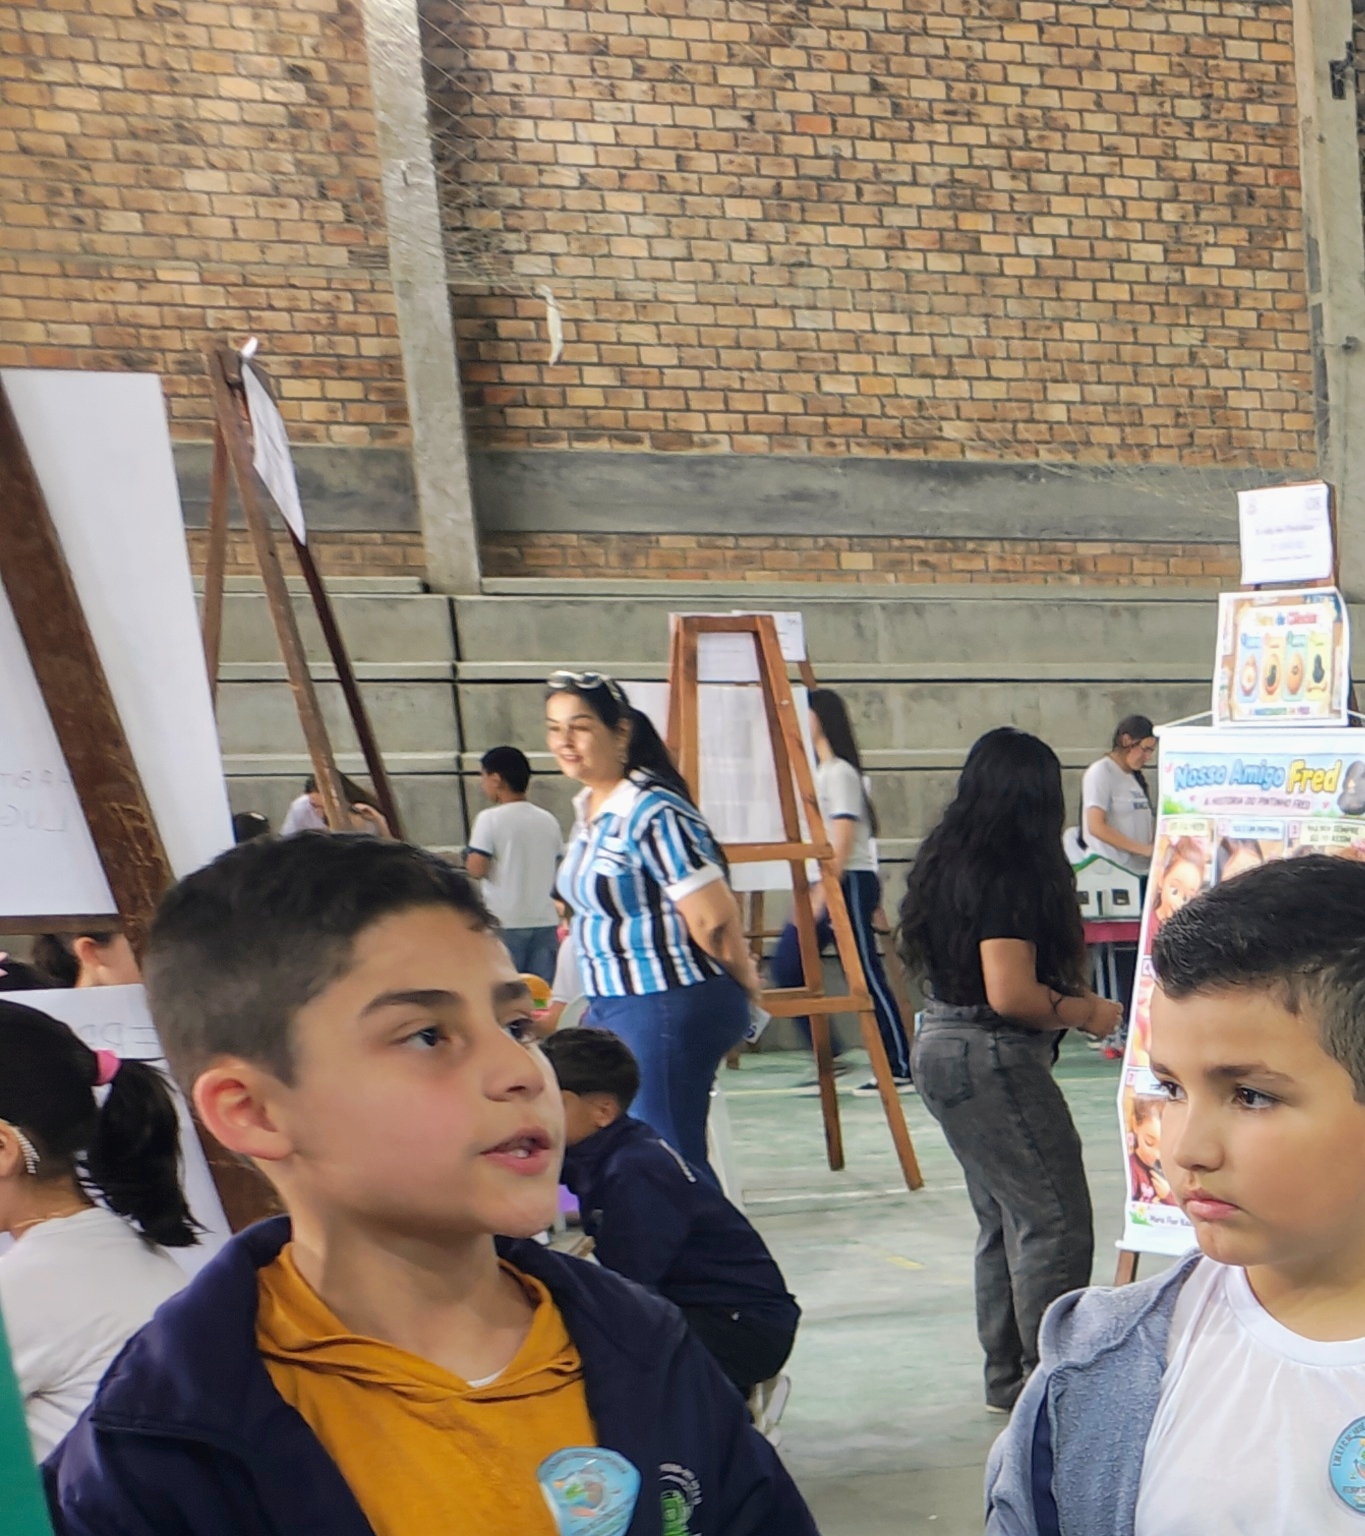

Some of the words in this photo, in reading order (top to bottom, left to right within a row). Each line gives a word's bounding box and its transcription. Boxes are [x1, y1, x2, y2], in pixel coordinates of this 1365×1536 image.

[1174, 763, 1228, 792] Nosso
[1229, 759, 1286, 791] Amigo
[1286, 758, 1343, 794] Fred
[1293, 798, 1311, 810] FRED
